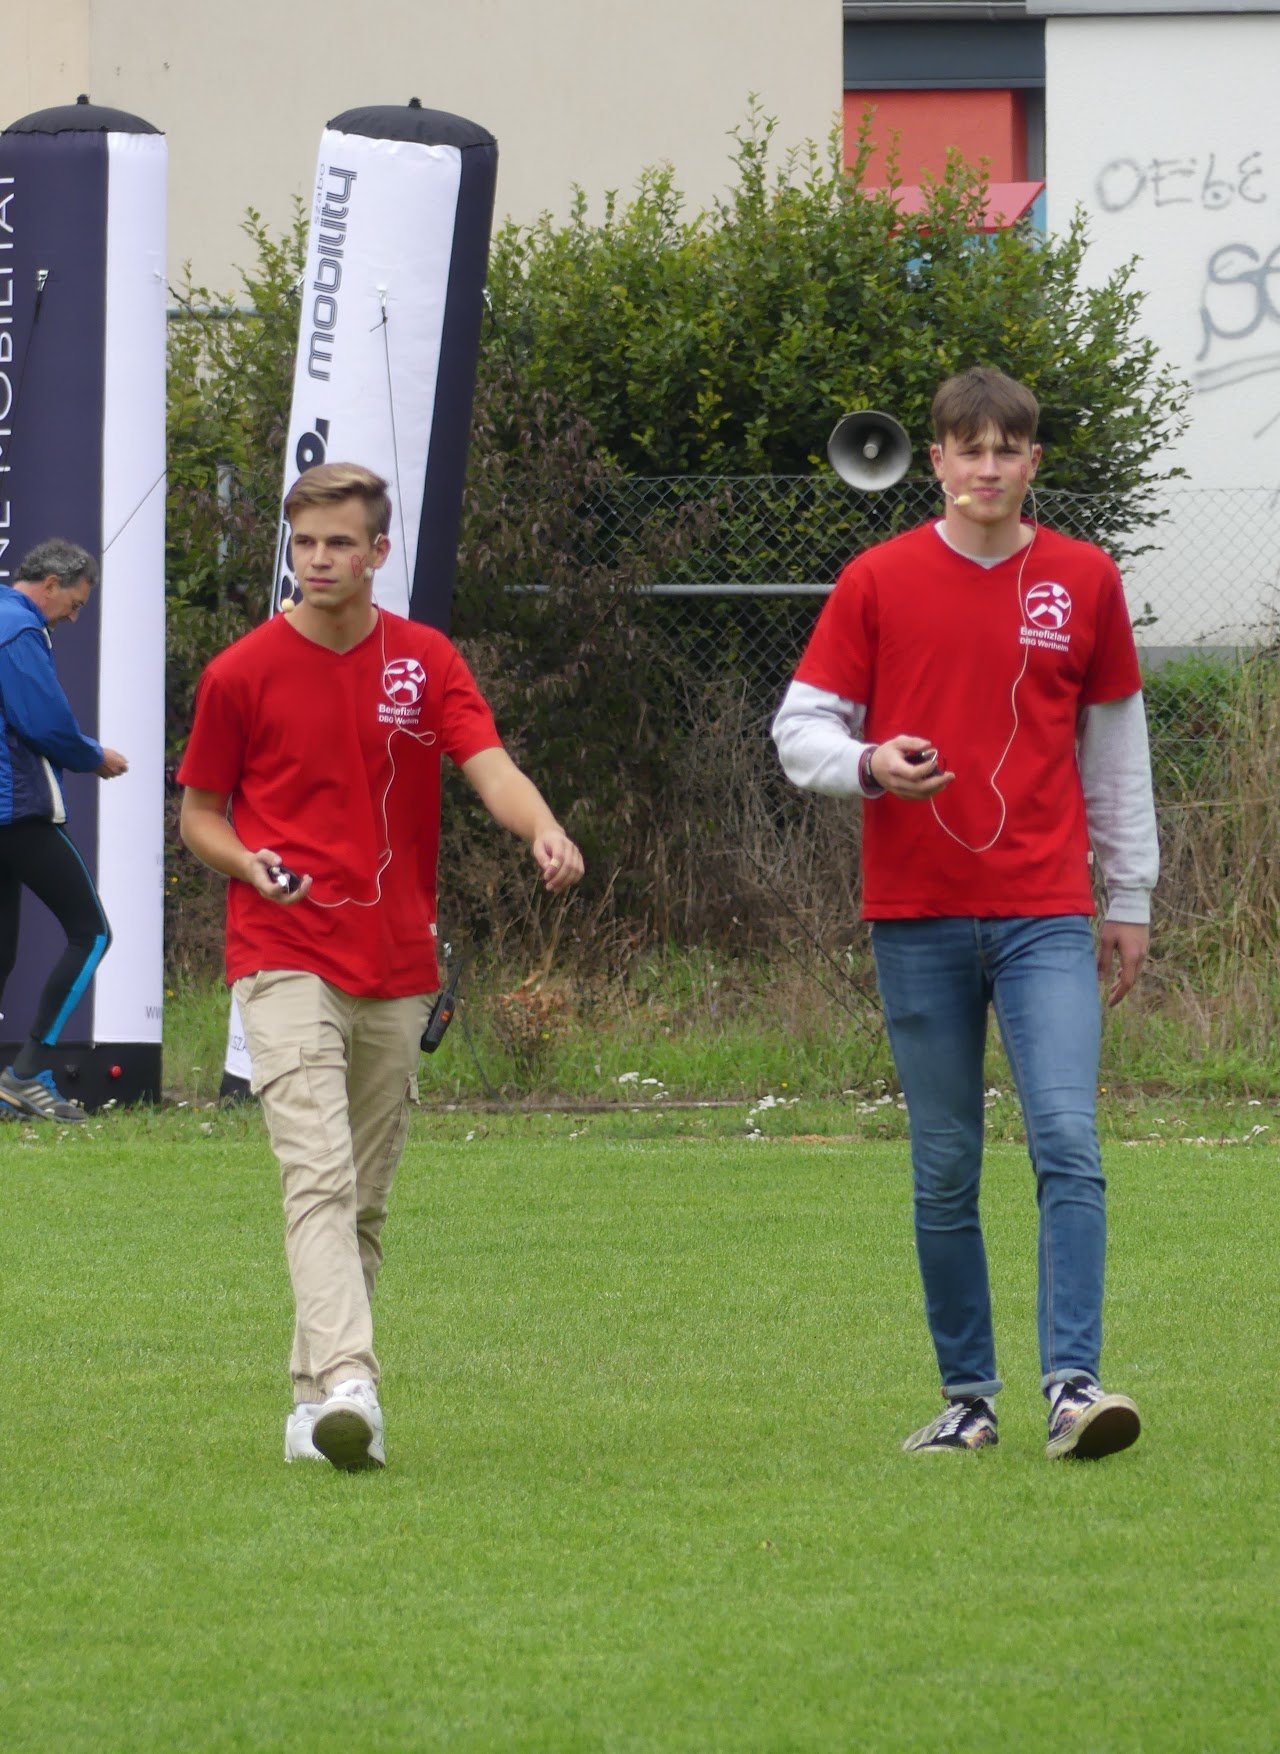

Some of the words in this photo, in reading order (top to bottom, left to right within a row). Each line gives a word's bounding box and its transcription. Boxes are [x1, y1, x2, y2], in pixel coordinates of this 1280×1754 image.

[307, 165, 358, 382] mobility
[1020, 627, 1071, 643] Benefizlauf
[1037, 639, 1069, 651] Wertheim
[379, 704, 421, 716] Benefizlf
